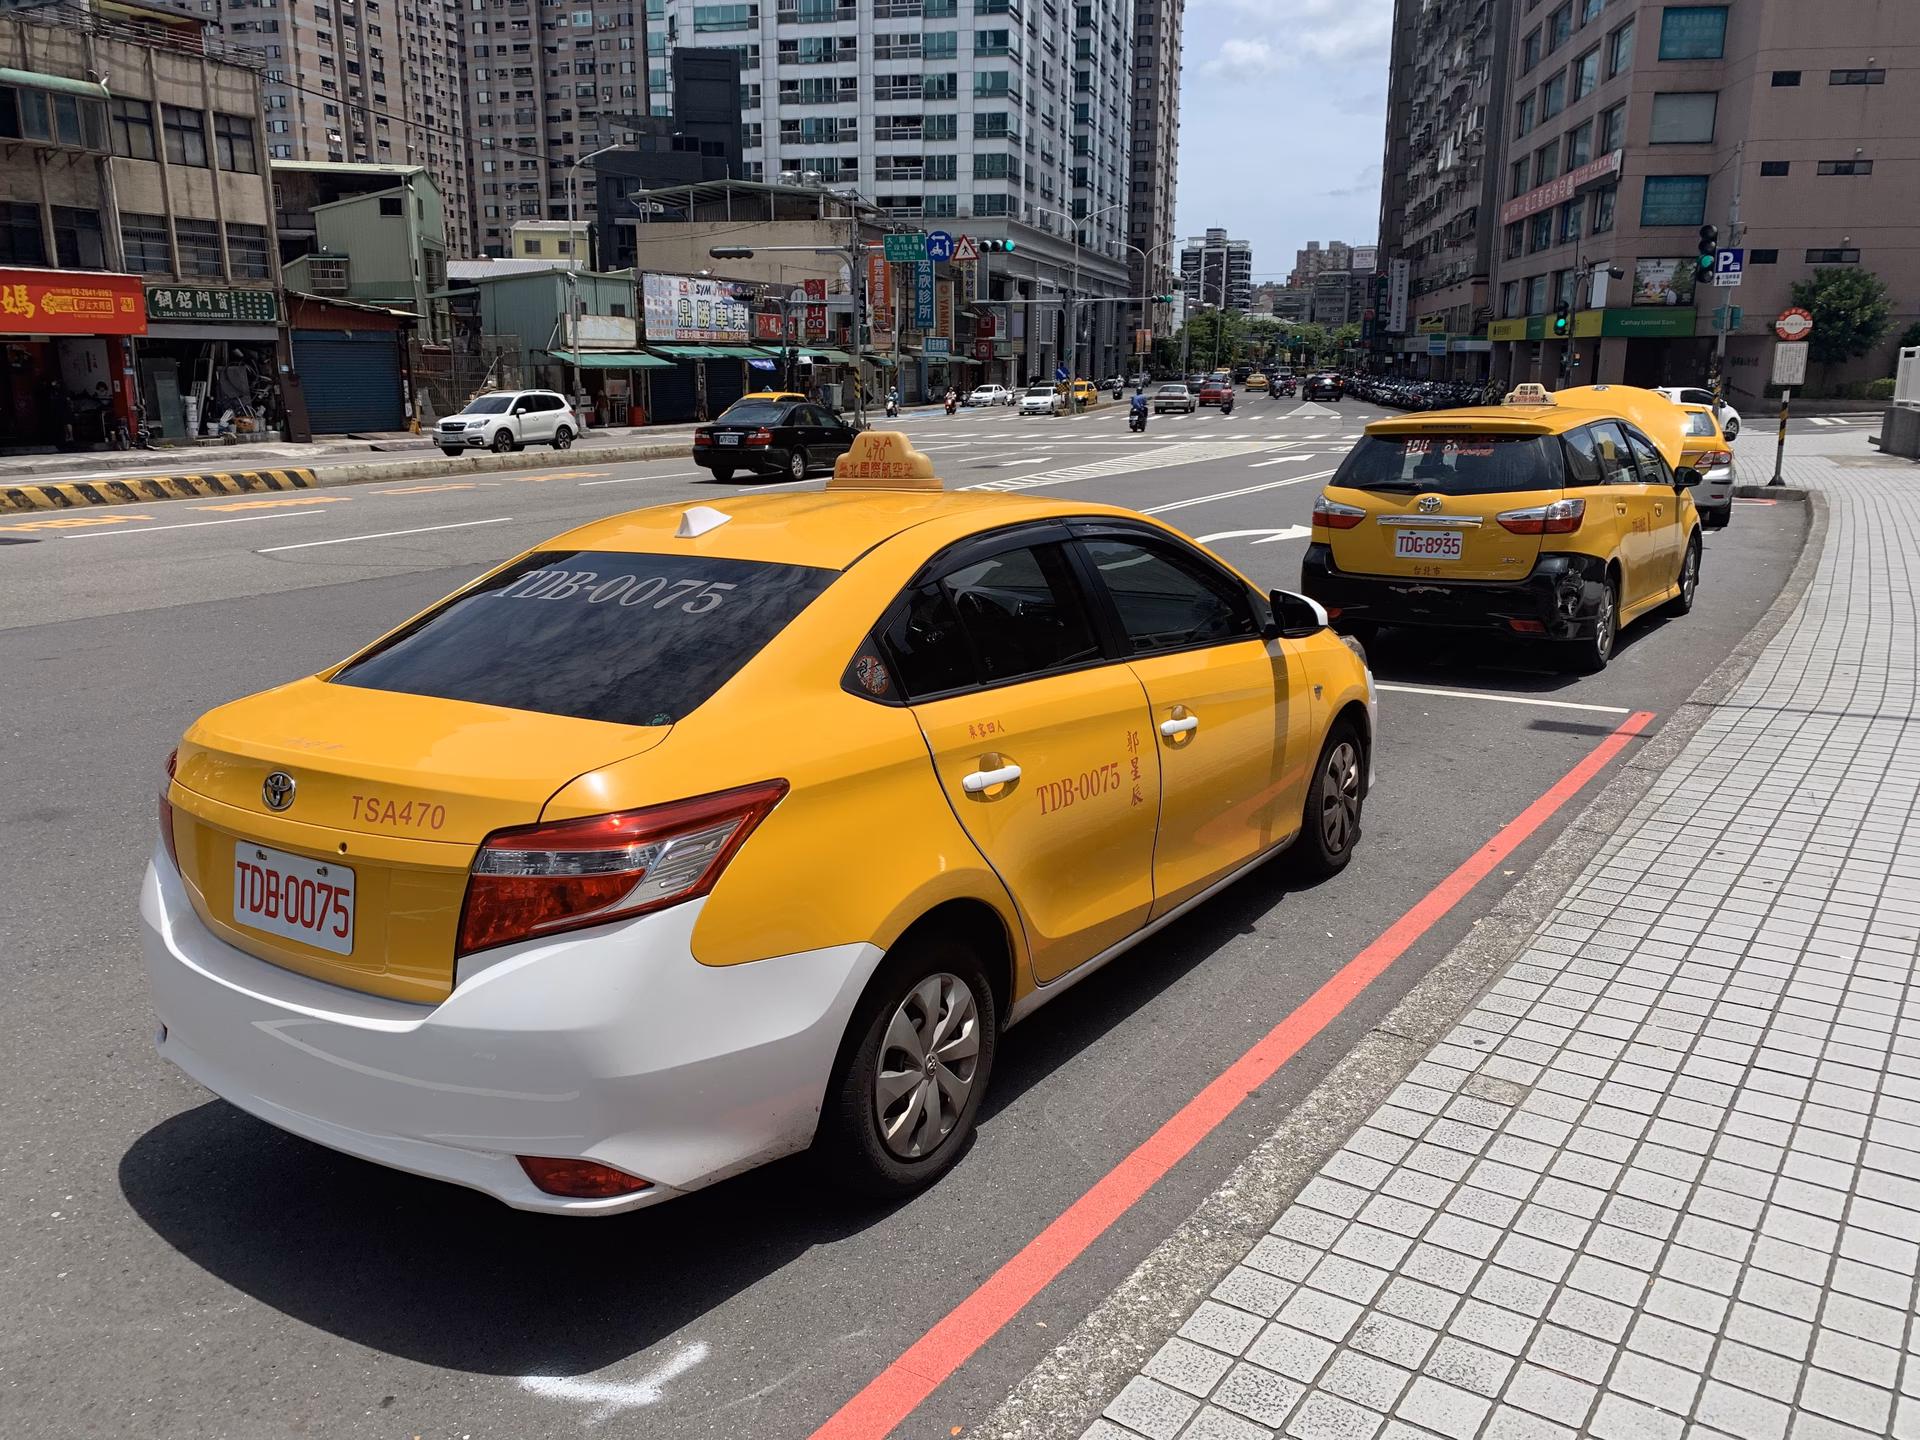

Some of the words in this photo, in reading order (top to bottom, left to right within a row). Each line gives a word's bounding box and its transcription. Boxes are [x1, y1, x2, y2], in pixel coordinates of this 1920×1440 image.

[1718, 252, 1734, 272] P
[696, 284, 711, 296] SYM
[918, 259, 931, 319] 宏欣診所
[678, 298, 746, 330] 鼎勝車業
[866, 447, 885, 461] 470
[1413, 565, 1442, 576] 台北市
[491, 570, 739, 614] TDB-0075
[968, 720, 1006, 740] 乘客四人
[1036, 762, 1121, 816] TDB-0075
[352, 795, 446, 830] TSA470
